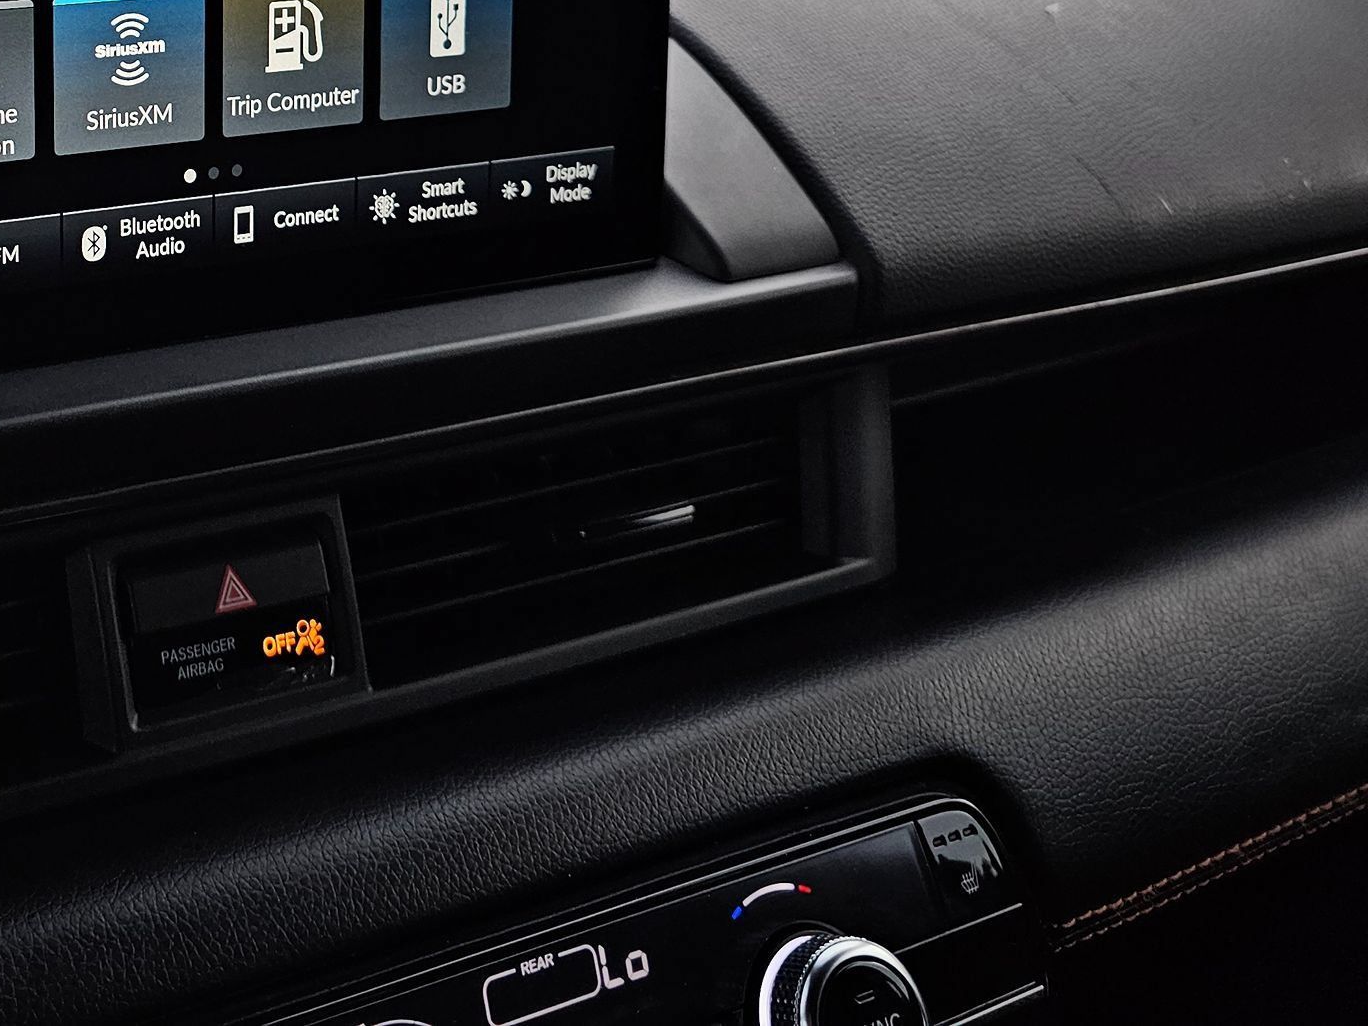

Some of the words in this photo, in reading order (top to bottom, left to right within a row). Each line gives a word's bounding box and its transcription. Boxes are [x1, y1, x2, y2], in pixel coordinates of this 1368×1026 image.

[427, 74, 466, 96] USB
[226, 94, 262, 119] Trip
[266, 86, 360, 113] Computer
[86, 102, 173, 131] SiriusXM
[545, 161, 598, 184] Display
[421, 177, 465, 199] Smart
[549, 184, 592, 204] Mode
[119, 210, 201, 237] Bluetooth
[273, 204, 340, 229] Connect
[407, 199, 478, 224] Shortcuts
[135, 237, 186, 260] Audio
[160, 636, 236, 665] PASSENGER
[262, 630, 296, 658] OFF
[177, 657, 225, 681] AIRBAG
[520, 952, 555, 976] REAR
